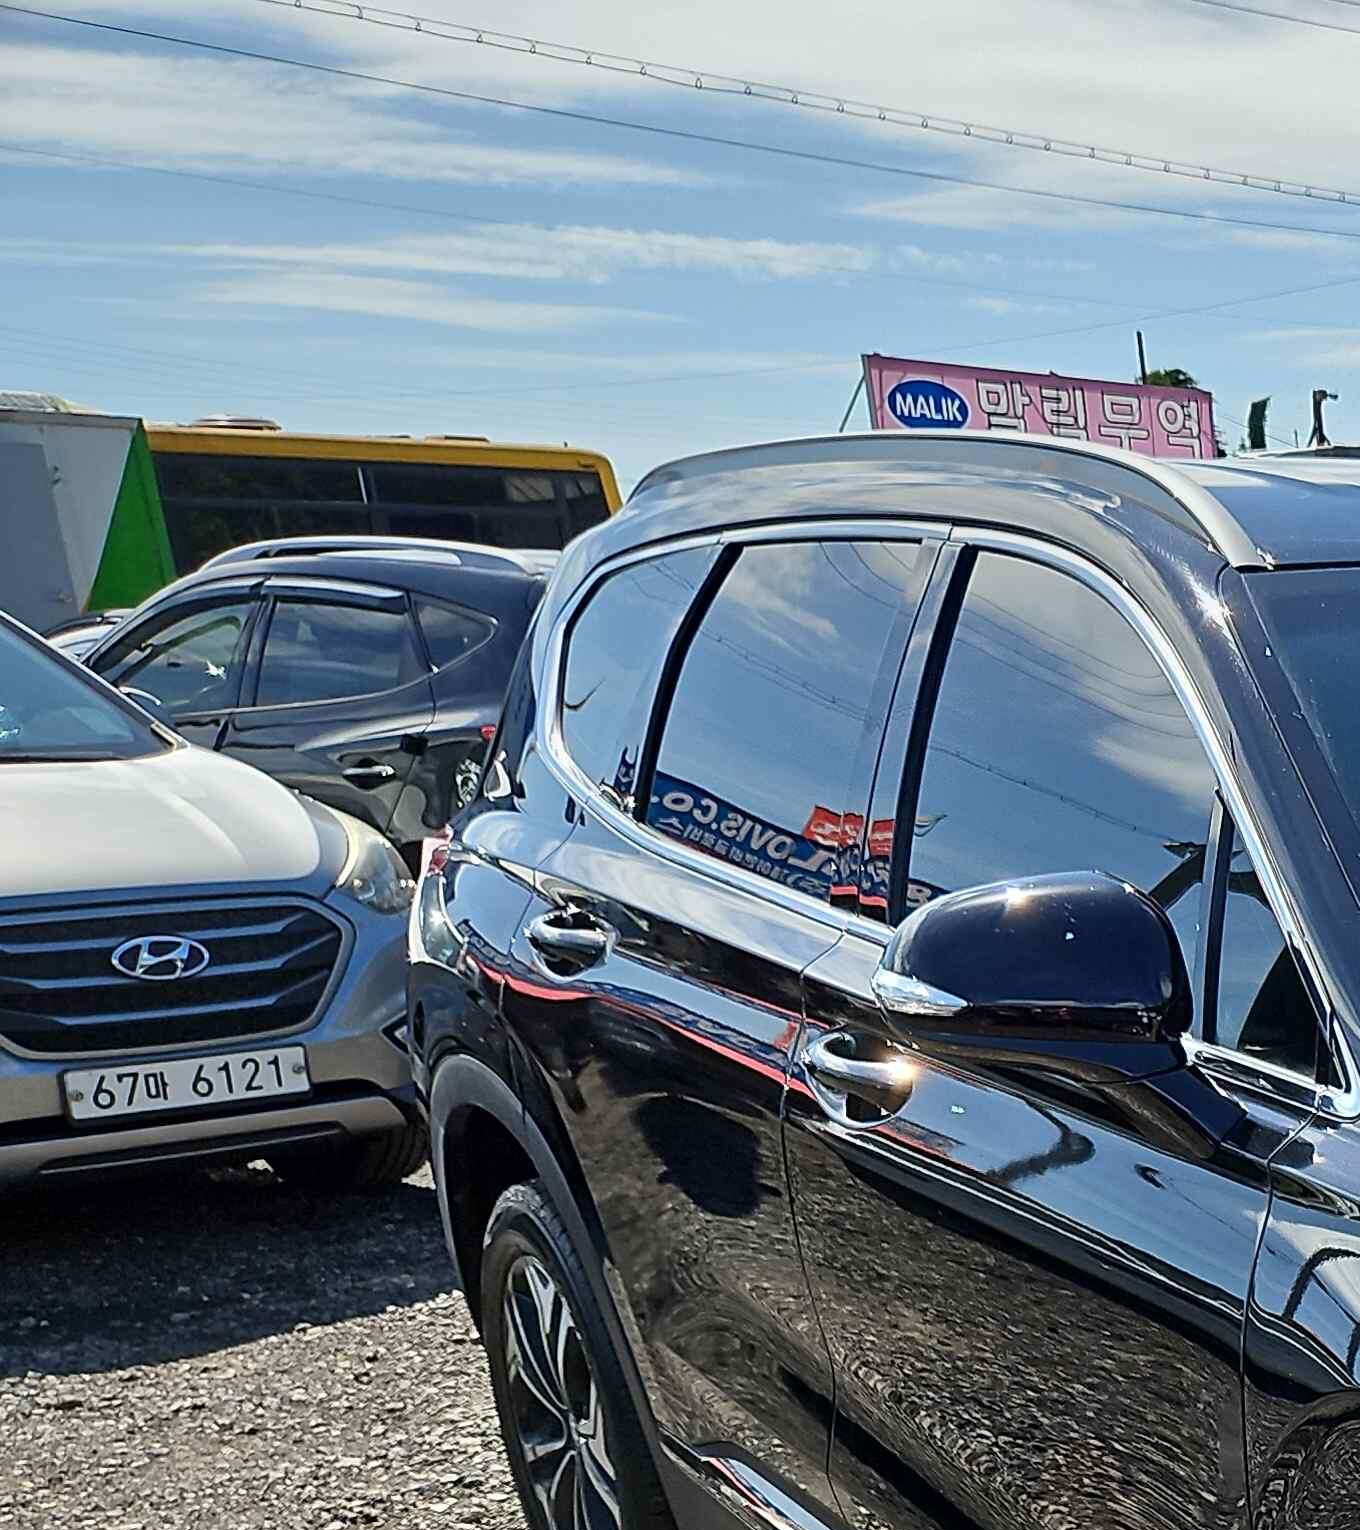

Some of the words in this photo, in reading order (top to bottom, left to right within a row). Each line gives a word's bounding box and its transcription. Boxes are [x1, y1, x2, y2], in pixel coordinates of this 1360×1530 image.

[895, 392, 964, 423] MALIK
[91, 1071, 170, 1110] 67마
[191, 1054, 284, 1098] 6121
